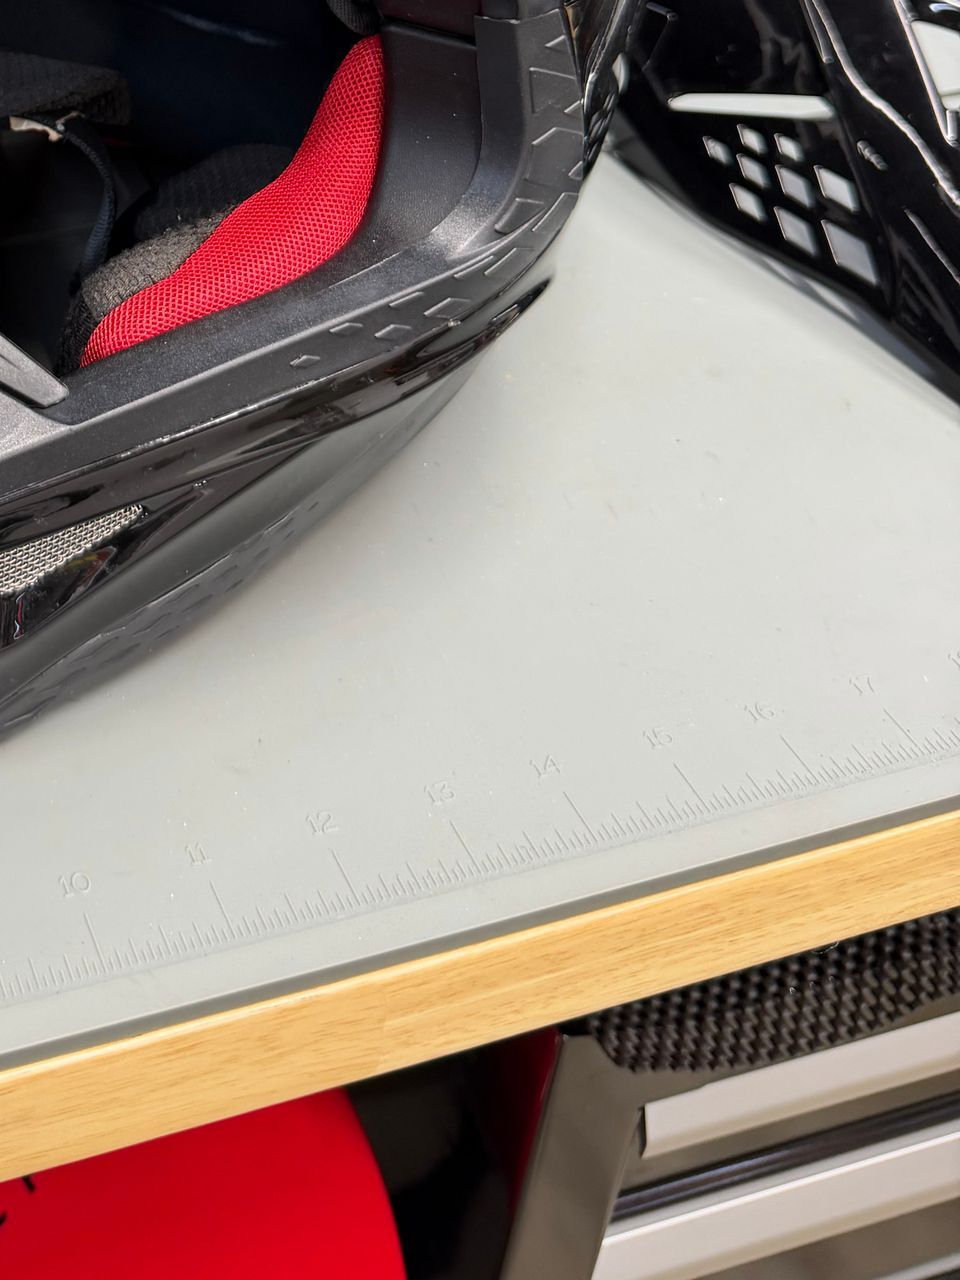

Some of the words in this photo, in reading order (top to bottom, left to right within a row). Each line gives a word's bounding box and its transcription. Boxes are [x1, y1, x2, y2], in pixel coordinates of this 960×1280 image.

[58, 871, 91, 898] 10
[185, 841, 213, 866] 11
[305, 811, 339, 836] 12
[423, 780, 456, 806] 13
[529, 754, 562, 779] 14
[642, 727, 673, 750] 15
[743, 701, 775, 724] 16
[847, 674, 877, 697] 17
